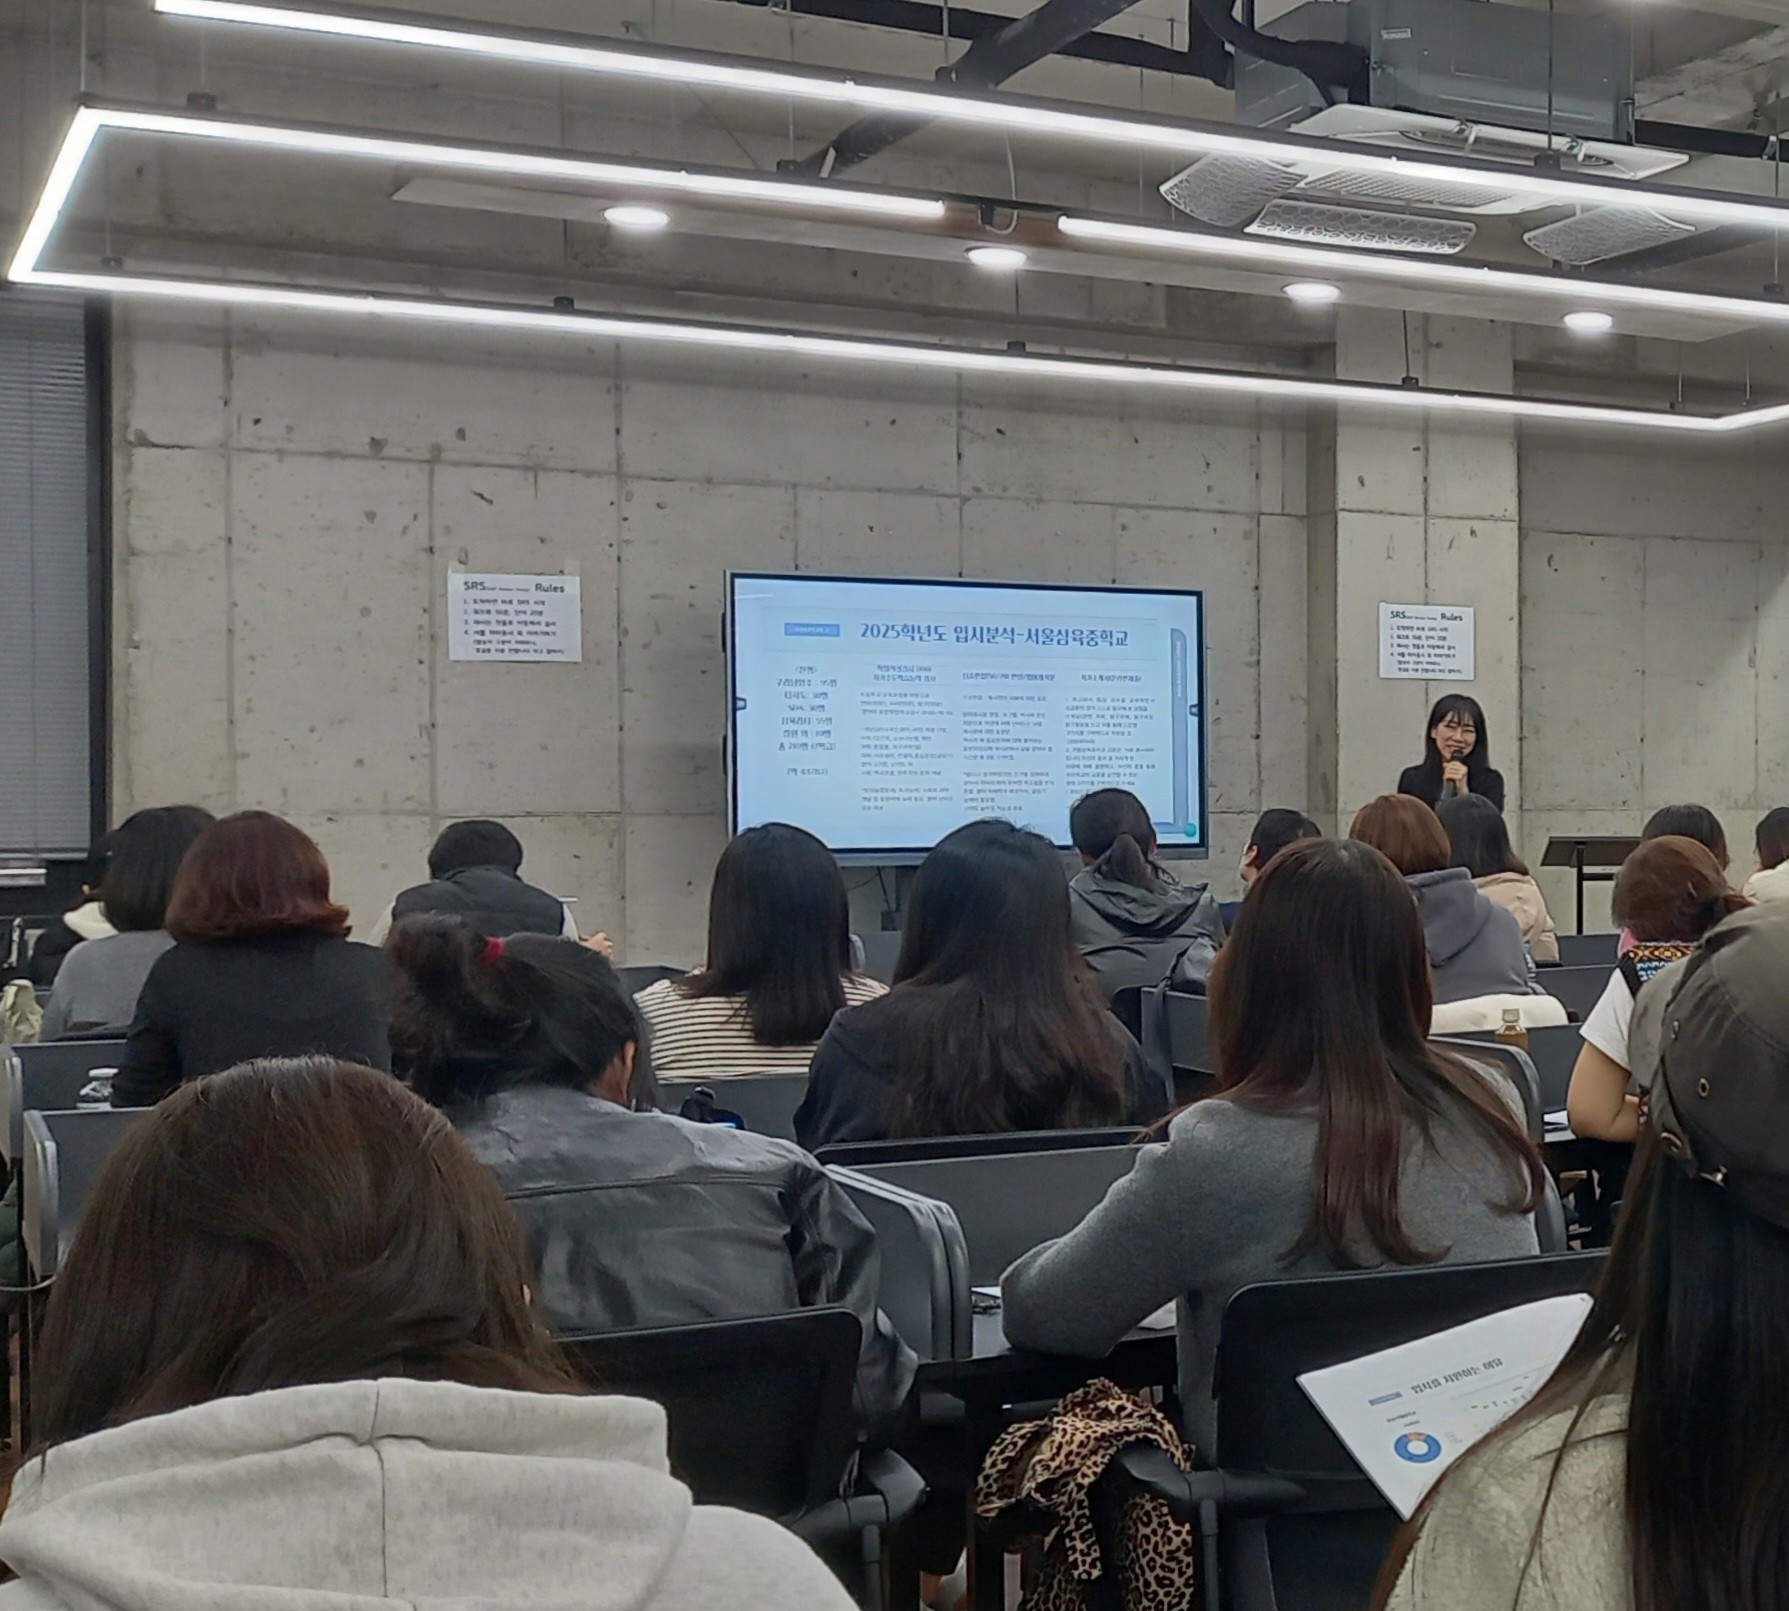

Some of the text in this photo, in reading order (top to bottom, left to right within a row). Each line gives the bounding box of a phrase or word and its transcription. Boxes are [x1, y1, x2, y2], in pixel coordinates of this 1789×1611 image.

[463, 581, 486, 591] SRS
[535, 583, 565, 593] Rules
[860, 622, 948, 643] 2025학년도
